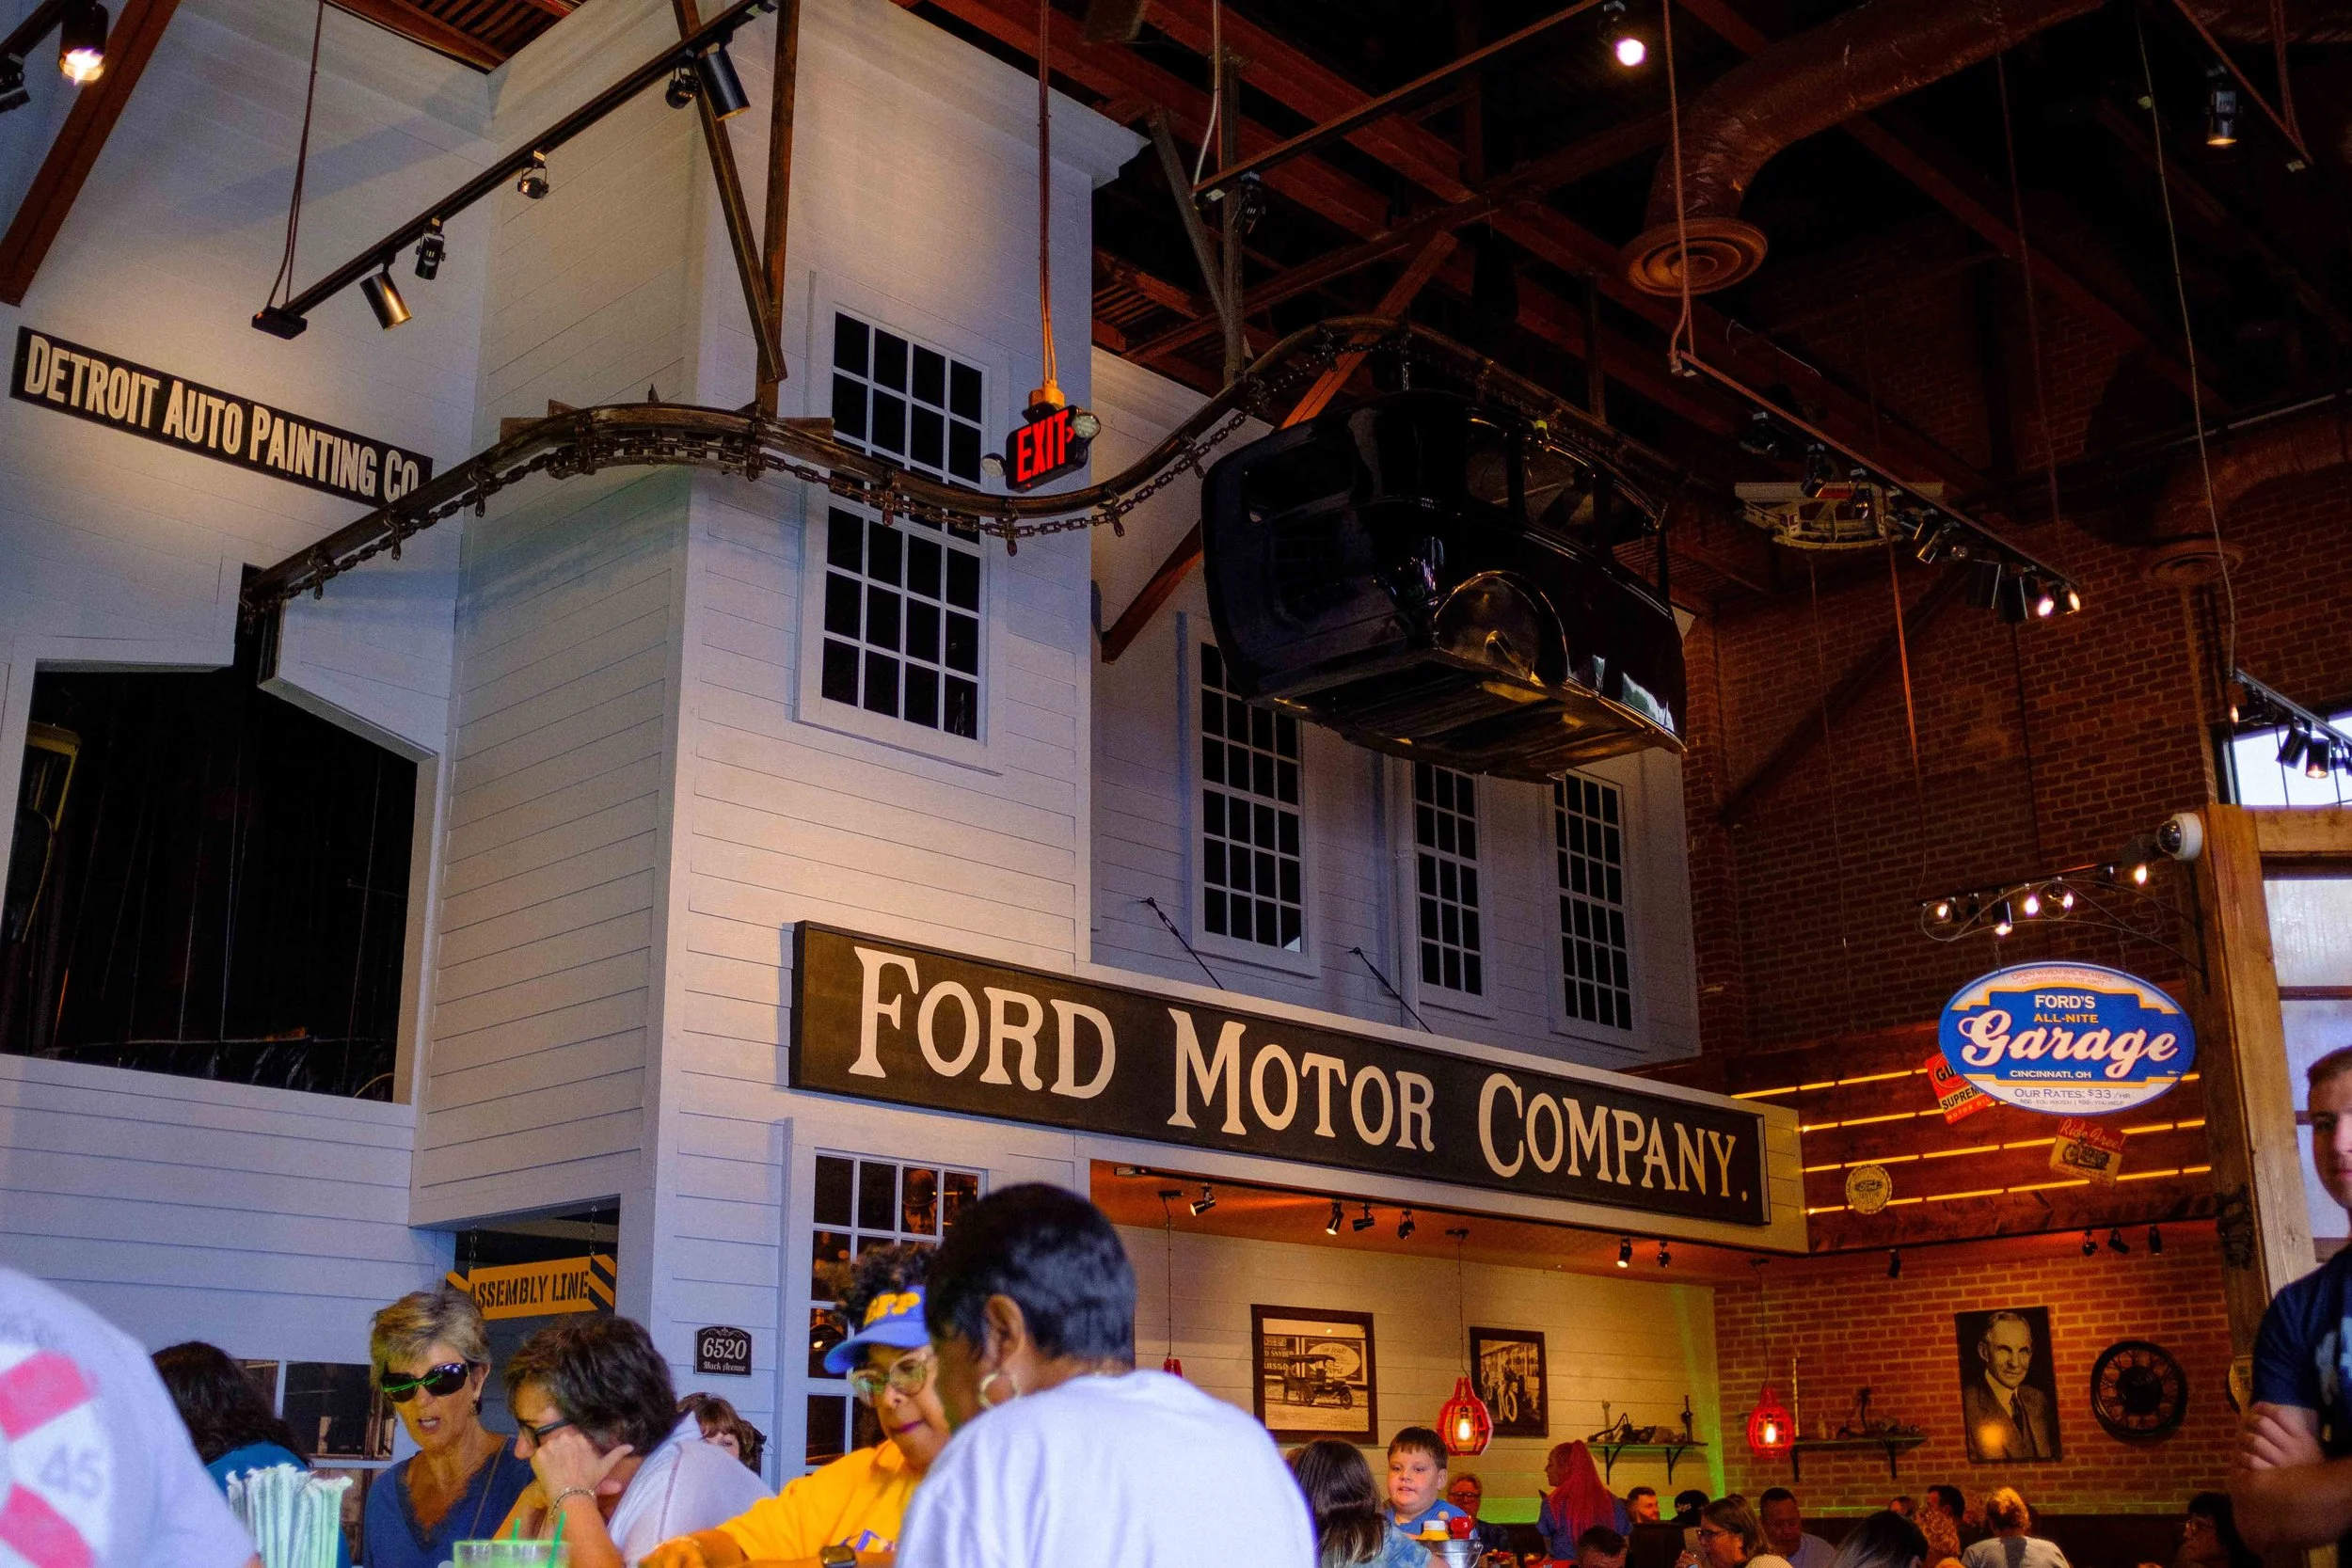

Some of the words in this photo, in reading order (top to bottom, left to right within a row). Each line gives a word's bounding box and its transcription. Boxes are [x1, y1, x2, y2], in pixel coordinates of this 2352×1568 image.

[24, 335, 159, 428] DETROIT
[163, 380, 243, 455] AUTO
[249, 405, 377, 498] PAINTING
[384, 450, 419, 503] CO
[1017, 409, 1069, 483] EXIT
[2034, 994, 2096, 1009] FORD'S
[2033, 1013, 2099, 1023] ALL-NITE
[1958, 1009, 2179, 1079] Garage
[848, 946, 1117, 1100] FORD
[1168, 1007, 1435, 1151] MOTOR
[1478, 1073, 1749, 1202] COMPANY.
[1936, 1063, 1957, 1082] GU
[2010, 1069, 2074, 1079] CINCINNATI,
[2074, 1070, 2092, 1079] OH
[2014, 1088, 2041, 1098] OUR
[551, 1270, 590, 1302] LINE
[702, 1337, 747, 1360] 6520
